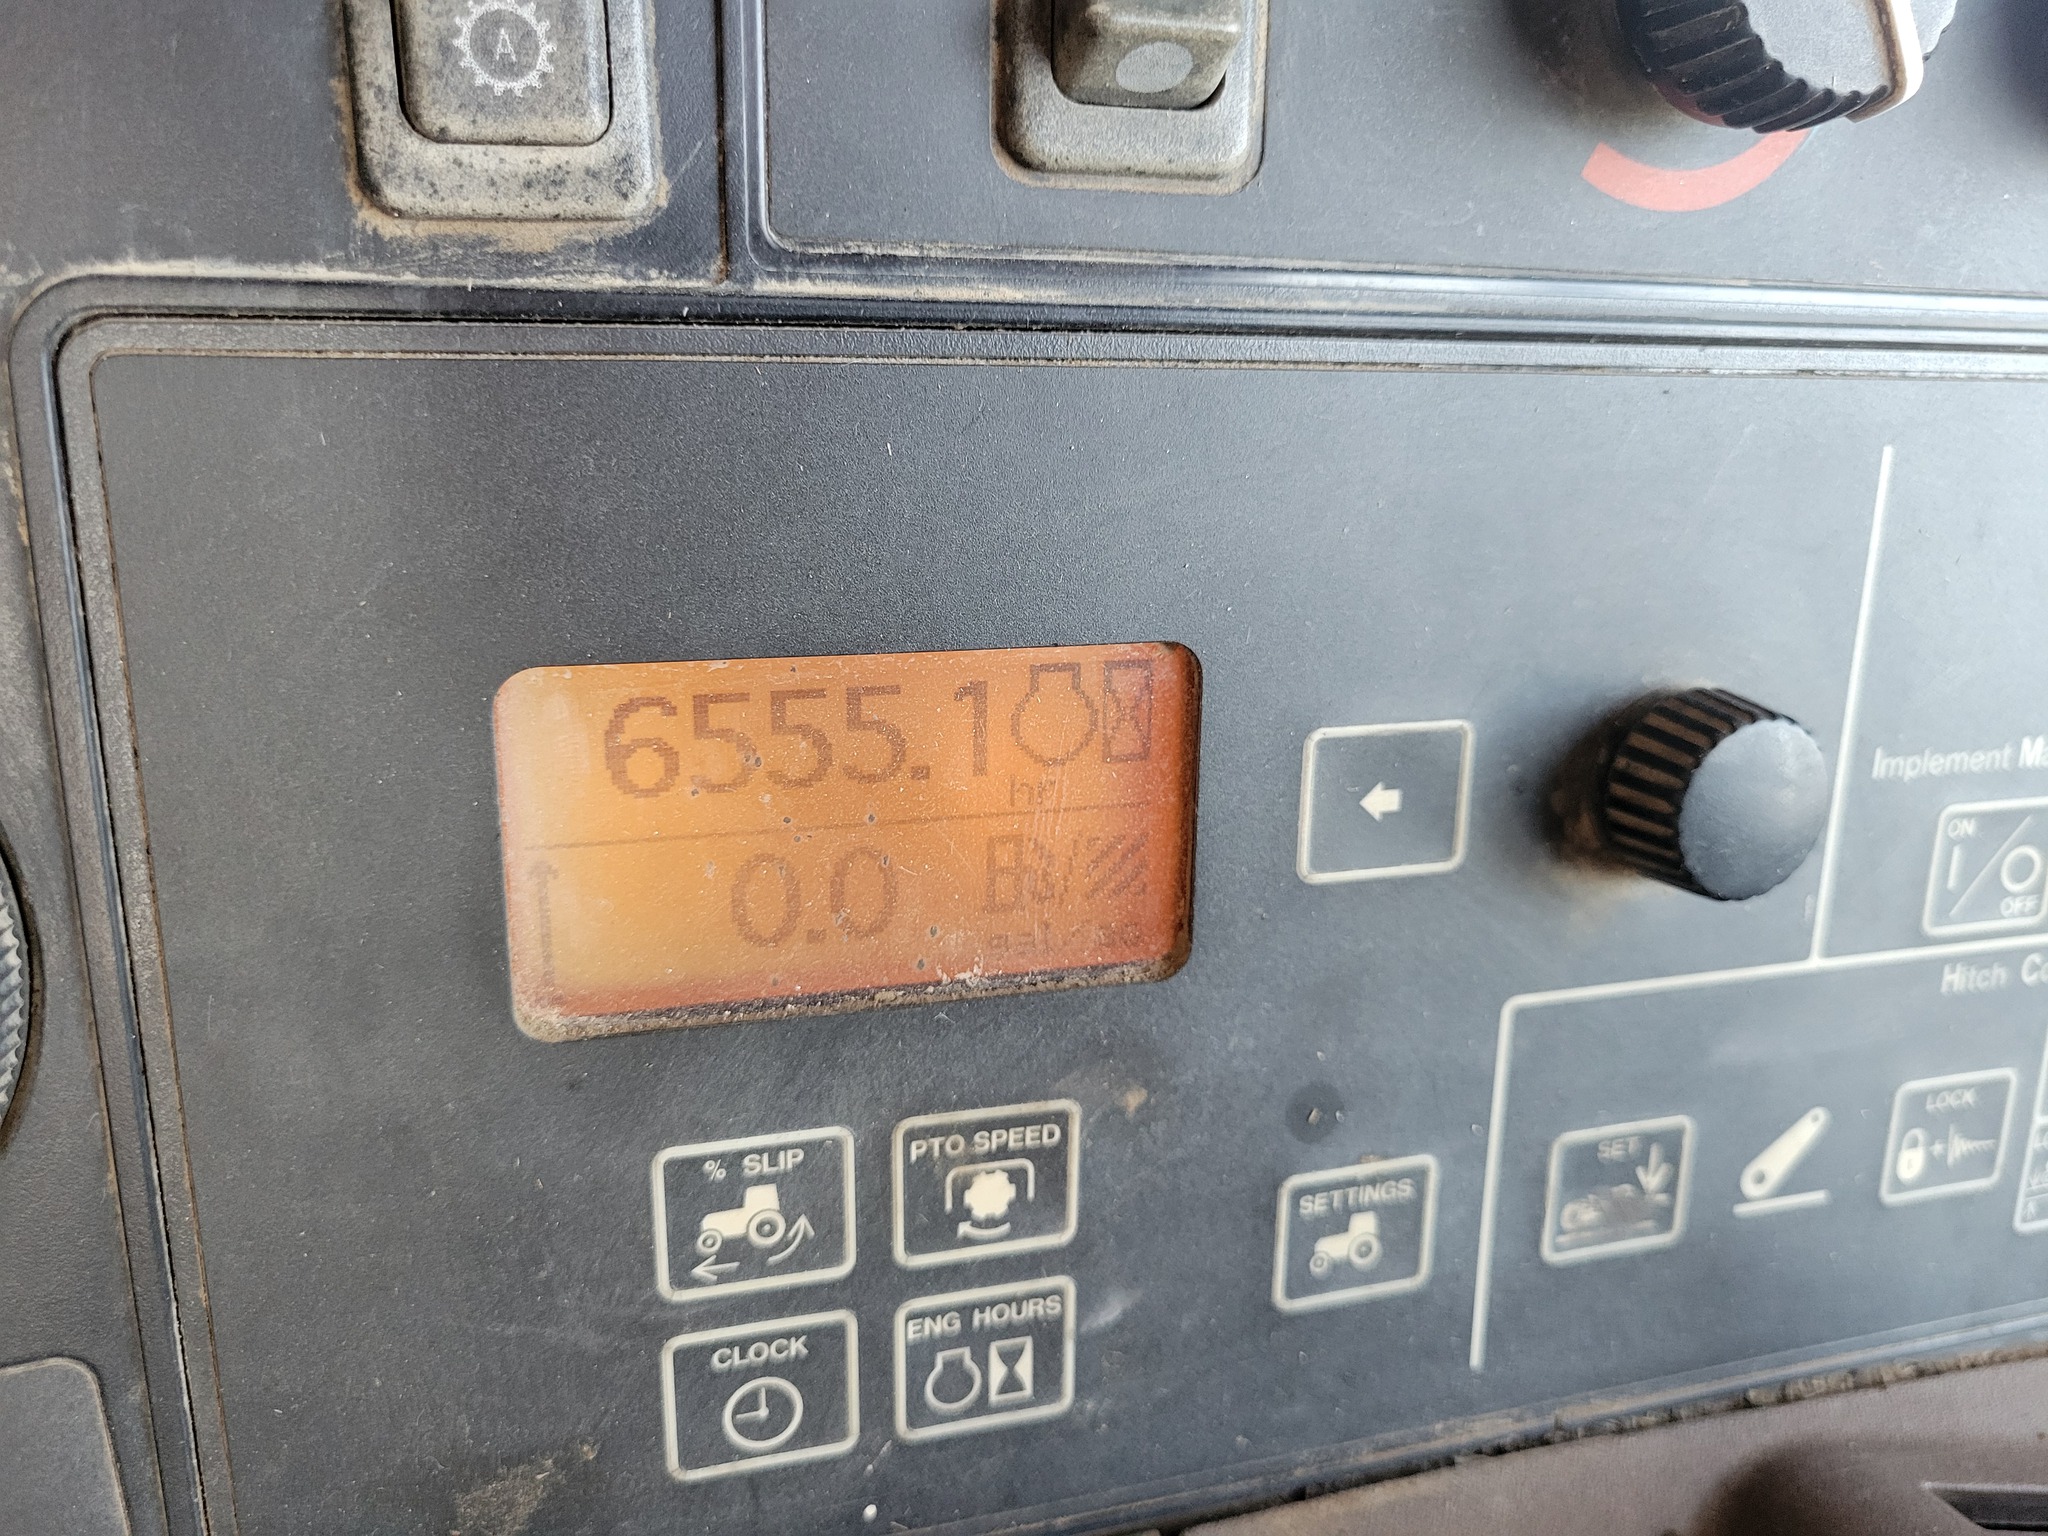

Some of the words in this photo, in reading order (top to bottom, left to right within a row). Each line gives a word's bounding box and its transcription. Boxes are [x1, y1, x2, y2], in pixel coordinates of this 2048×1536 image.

[496, 27, 516, 61] A
[603, 680, 990, 800] 6555.1
[1871, 742, 2012, 782] Implement
[1947, 816, 1976, 839] ON
[730, 845, 900, 948] 0.0
[2000, 894, 2039, 917] OFF
[1940, 961, 2008, 994] Hitch
[1925, 1086, 1976, 1112] LOCK
[910, 1132, 966, 1162] PTO
[972, 1122, 1063, 1155] SPEED
[1596, 1136, 1641, 1162] SET
[702, 1157, 727, 1181] %
[741, 1147, 806, 1175] SLIP
[1299, 1177, 1418, 1217] SETTINGS
[906, 1308, 962, 1342] ENG
[972, 1293, 1064, 1330] HOURS
[710, 1334, 810, 1370] CLOCK
